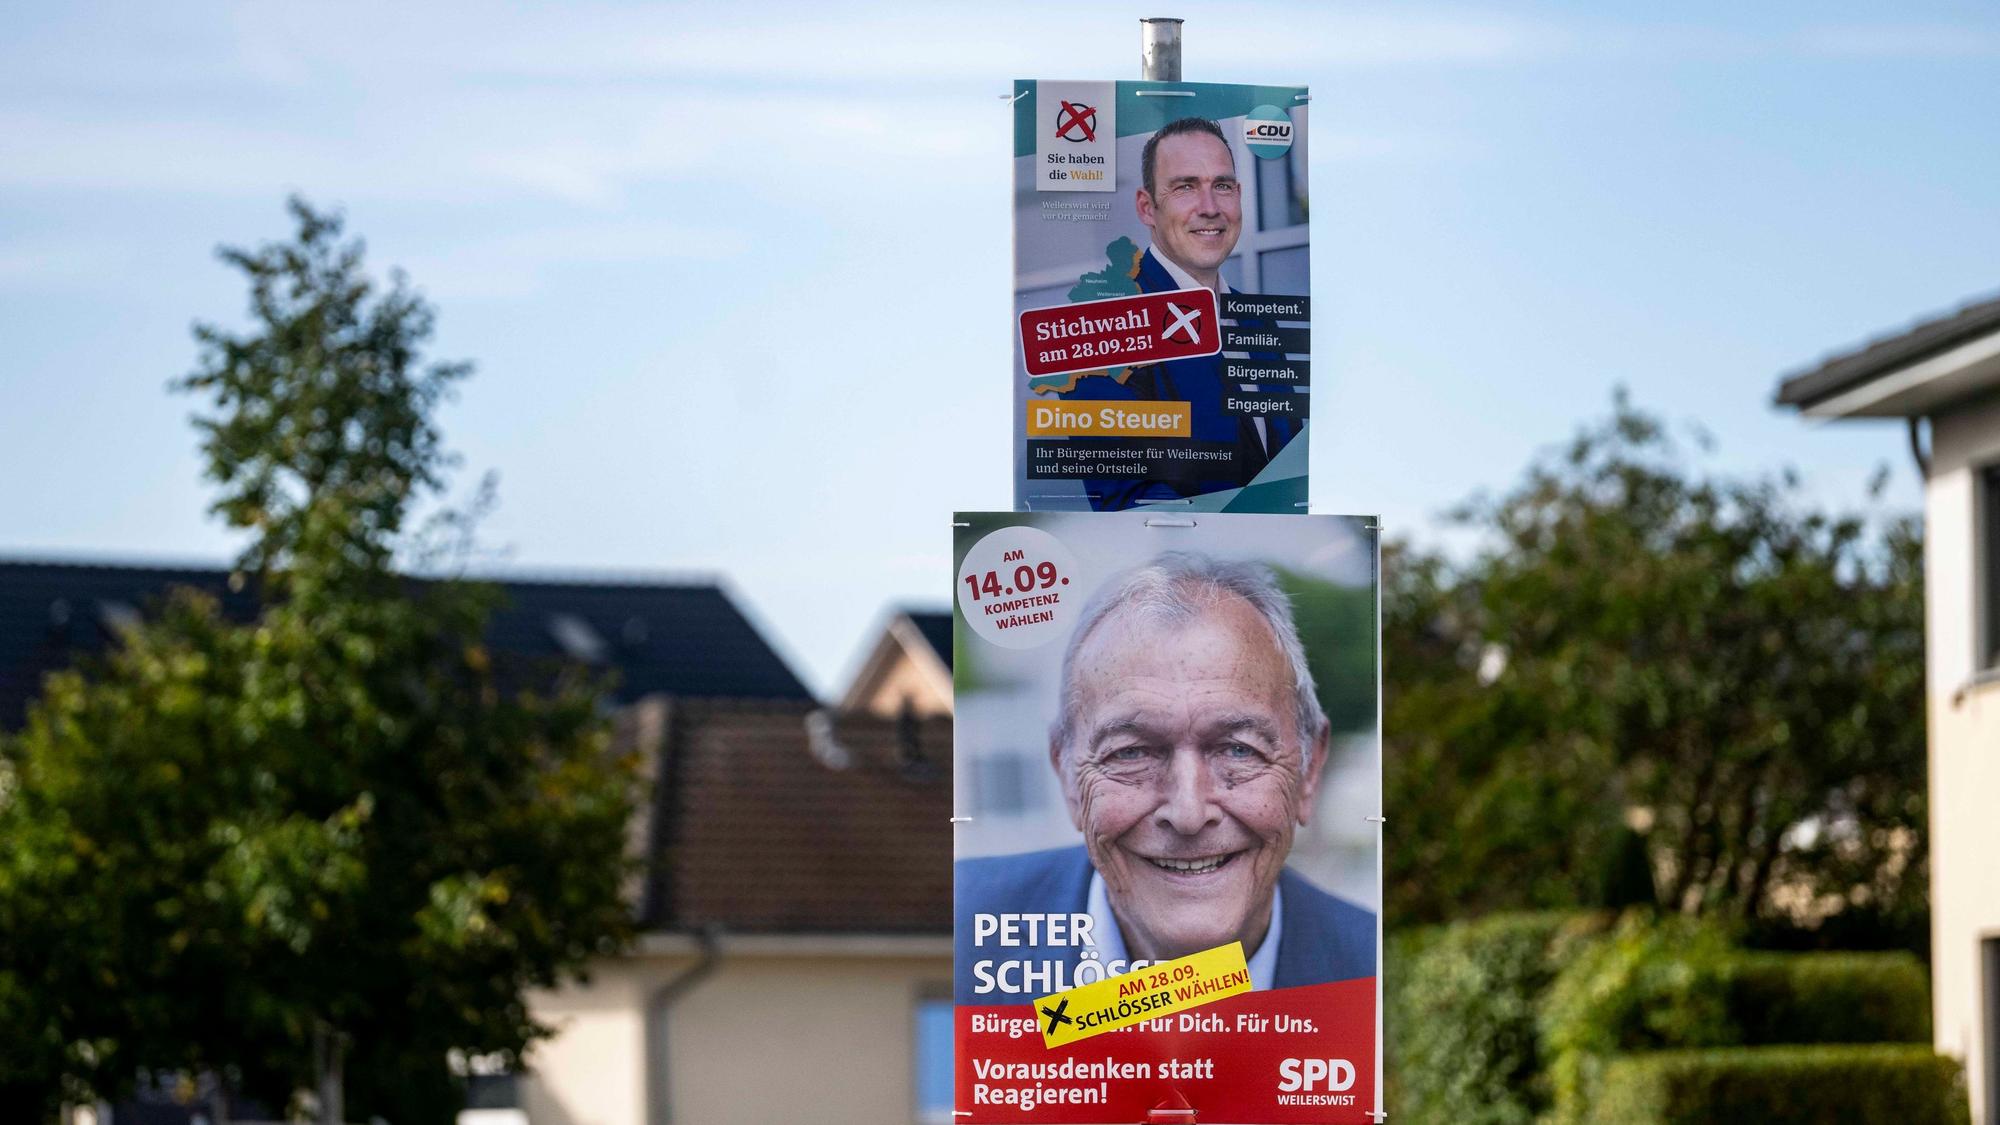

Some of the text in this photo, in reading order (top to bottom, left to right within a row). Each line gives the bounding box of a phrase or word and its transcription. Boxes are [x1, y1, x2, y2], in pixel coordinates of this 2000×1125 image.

[1257, 125, 1290, 137] CDU
[1047, 153, 1105, 164] Sie haben
[1049, 169, 1104, 181] die Wahl!
[1042, 201, 1110, 210] Weilerswist wird
[1227, 300, 1303, 316] Kompetent.
[1036, 308, 1151, 341] Stichwahl
[1039, 335, 1153, 363] am 28.09.25!
[1227, 333, 1282, 347] Familiär.
[1227, 365, 1299, 380] Bürgernah.
[1227, 398, 1294, 413] Engagiert.
[1036, 407, 1182, 430] Dino Steuer
[1036, 448, 1233, 461] Ihr Bürgermeister für Weilerswist
[1036, 463, 1148, 474] und seine Ortsteile
[1003, 550, 1024, 562] AM
[965, 561, 1069, 600] 14.09.
[984, 593, 1060, 615] KOMPETENZ
[996, 610, 1053, 629] WÄHLEN!
[974, 913, 1095, 947] PETER
[1119, 965, 1200, 998] AM 28.09.
[1076, 969, 1250, 1031] SCHLÖSSER WÄHLEN!
[1179, 1012, 1231, 1033] Dich.
[1236, 1013, 1270, 1033] Für
[1274, 1014, 1319, 1033] Uns.
[973, 1057, 1214, 1080] Vorausdenken statt
[1277, 1058, 1356, 1092] SPD
[973, 1082, 1108, 1112] Reagieren!
[1277, 1095, 1356, 1106] WEILERSWIST
